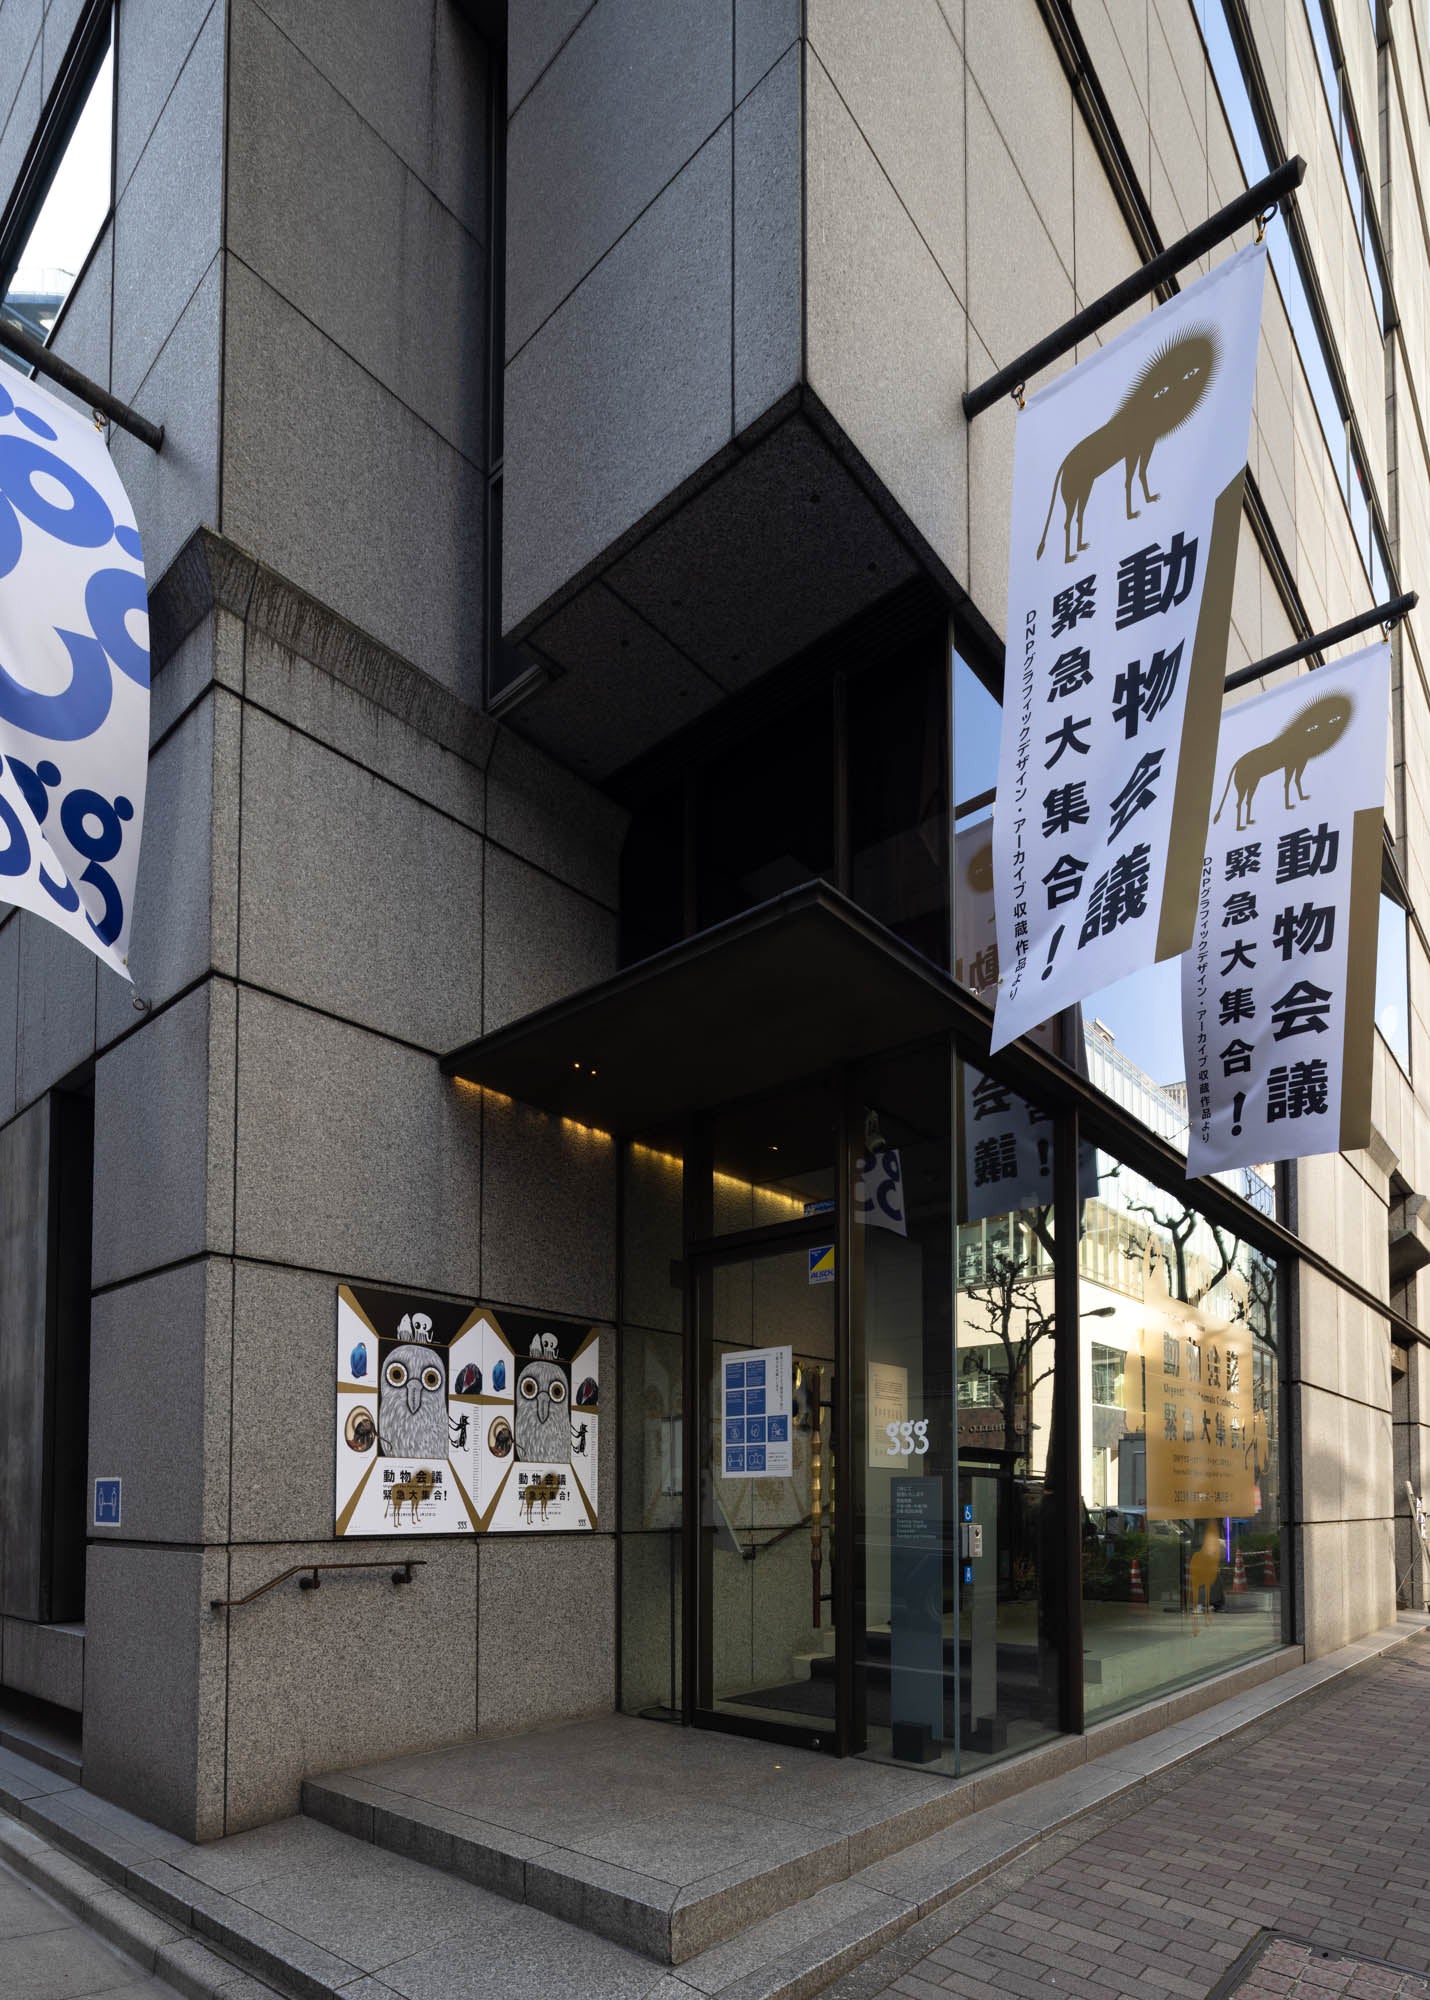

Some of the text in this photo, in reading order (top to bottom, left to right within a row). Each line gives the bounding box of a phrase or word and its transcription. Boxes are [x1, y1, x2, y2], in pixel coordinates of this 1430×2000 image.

[1041, 574, 1097, 981] 緊急大集合！
[1077, 531, 1199, 950] 動物会議
[1218, 841, 1262, 1137] 緊急大集合！
[1266, 822, 1340, 1123] 動物会議
[383, 1469, 443, 1484] 動物会議
[383, 1489, 448, 1501] 緊急大集合!
[518, 1472, 567, 1486] 動物会議
[886, 1418, 929, 1455] ggg
